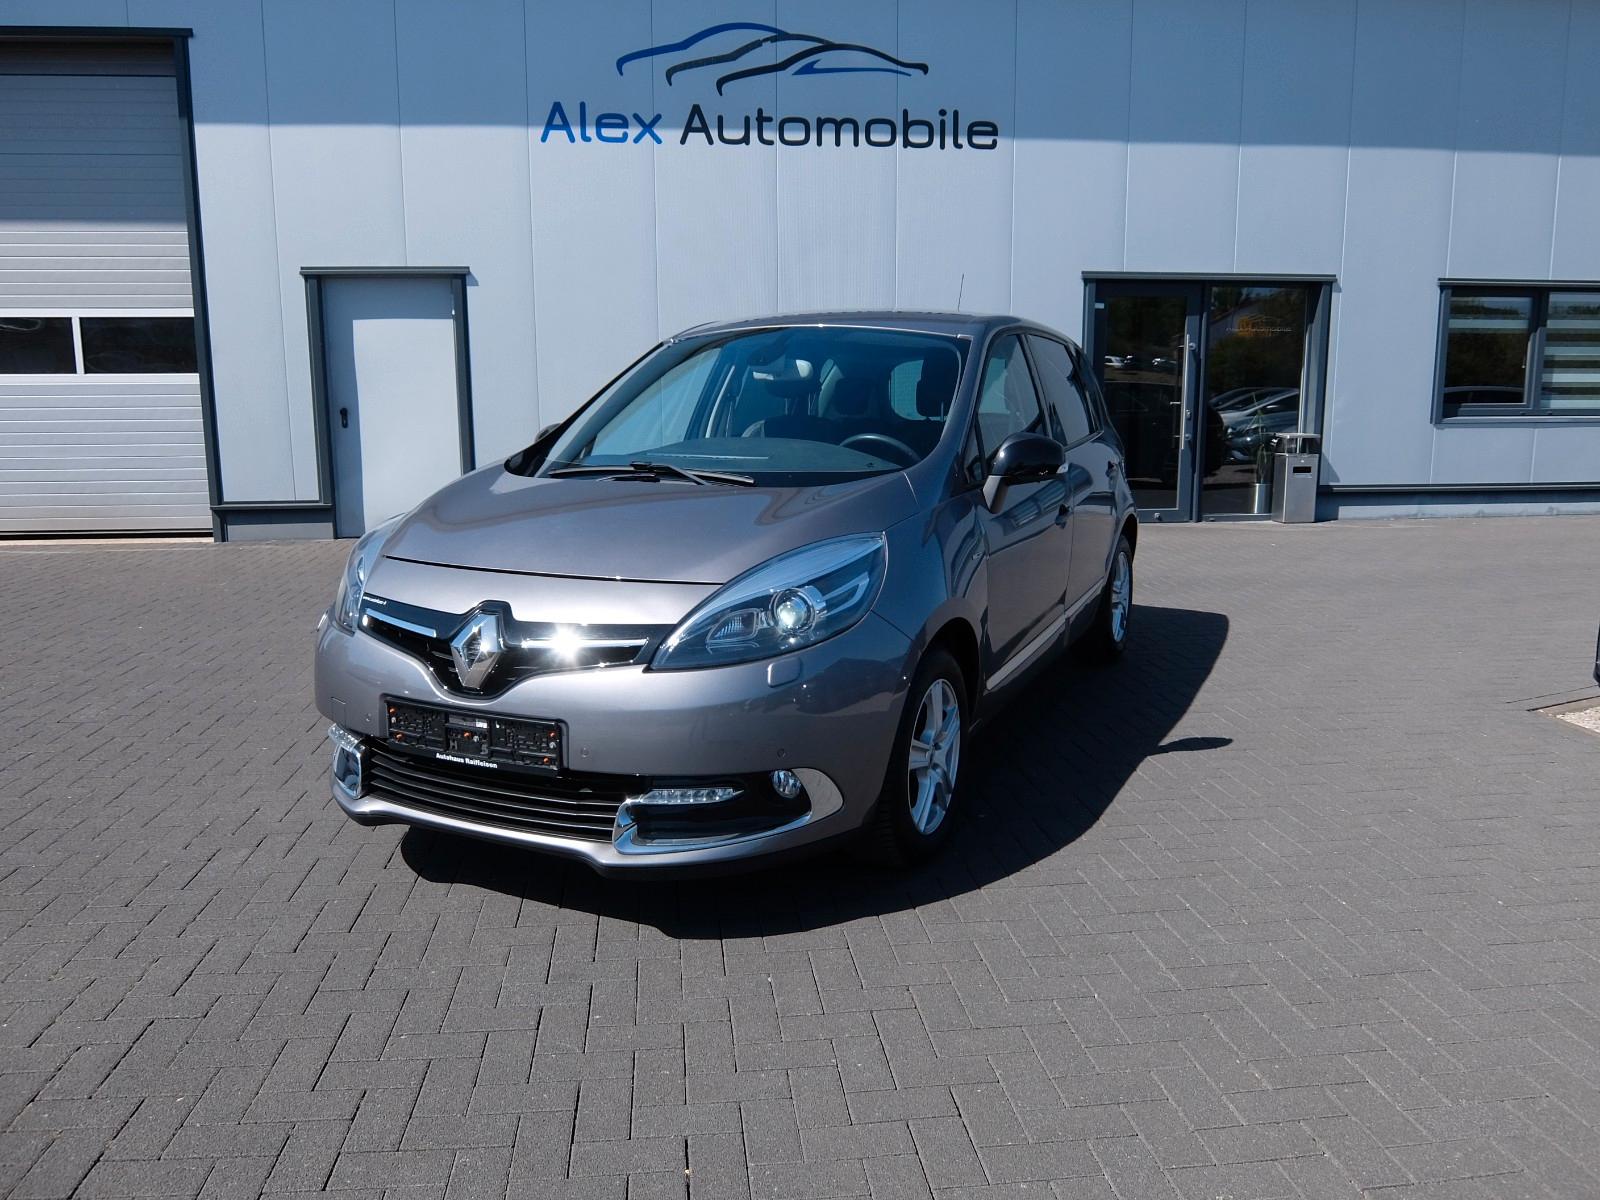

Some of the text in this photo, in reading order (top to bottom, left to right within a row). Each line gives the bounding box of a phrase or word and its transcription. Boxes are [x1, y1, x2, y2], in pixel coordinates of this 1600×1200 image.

[540, 101, 1000, 151] Alex Automobile
[436, 753, 464, 763] Autohaus
